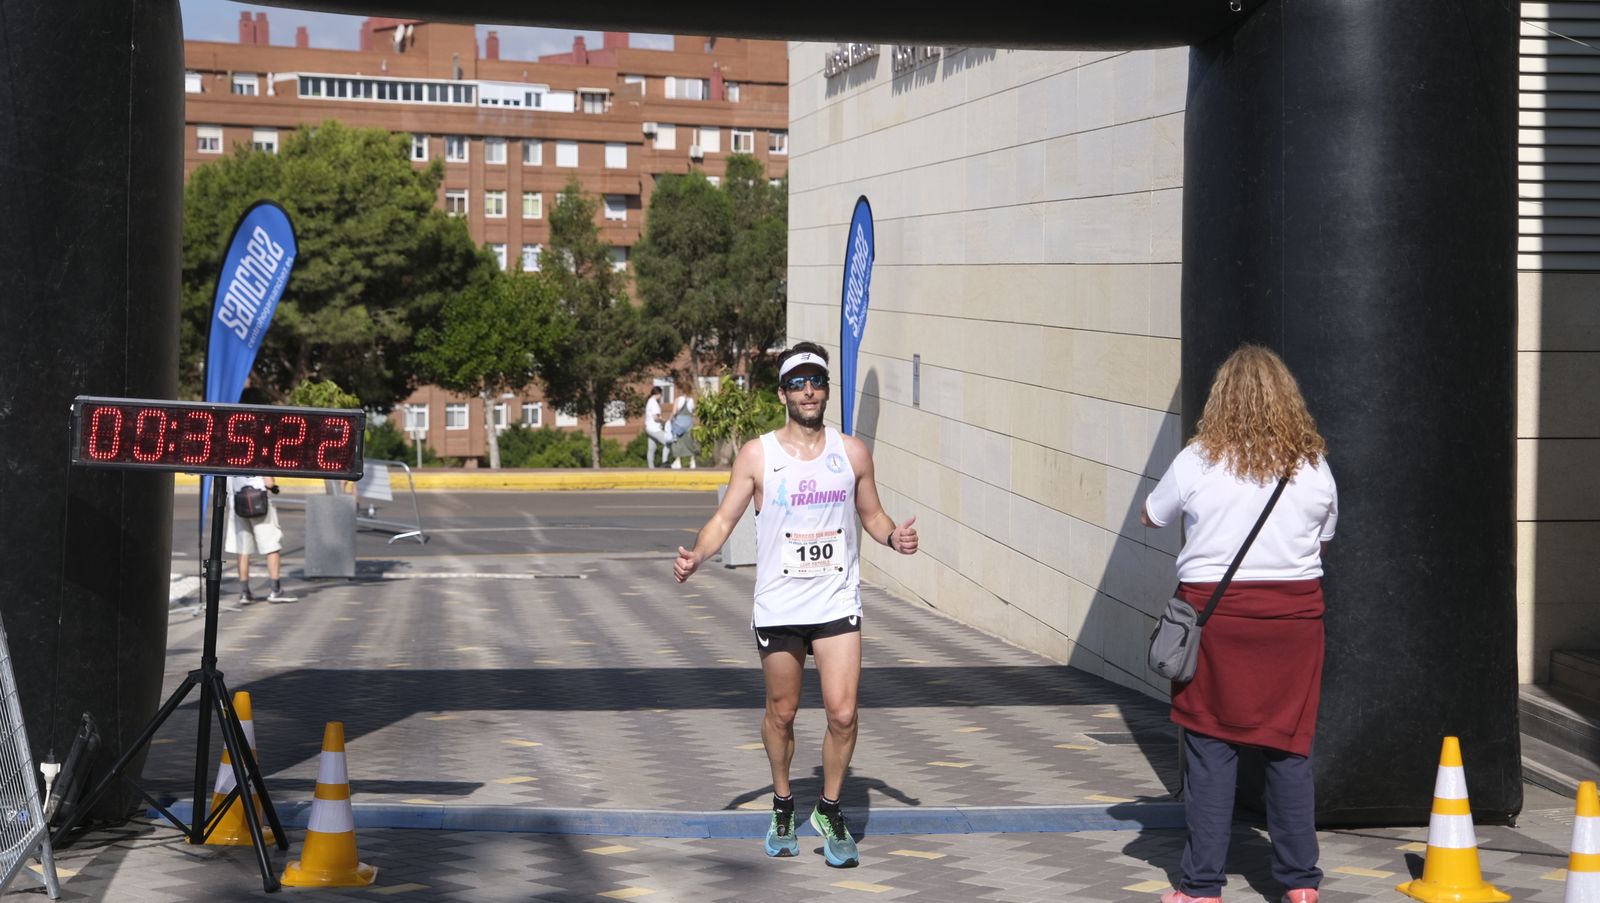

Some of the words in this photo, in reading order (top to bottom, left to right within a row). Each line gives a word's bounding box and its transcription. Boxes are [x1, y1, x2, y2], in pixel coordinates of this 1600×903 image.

[88, 407, 350, 469] 00:35:22
[790, 490, 846, 506] TRAINING
[796, 543, 834, 562] 190
